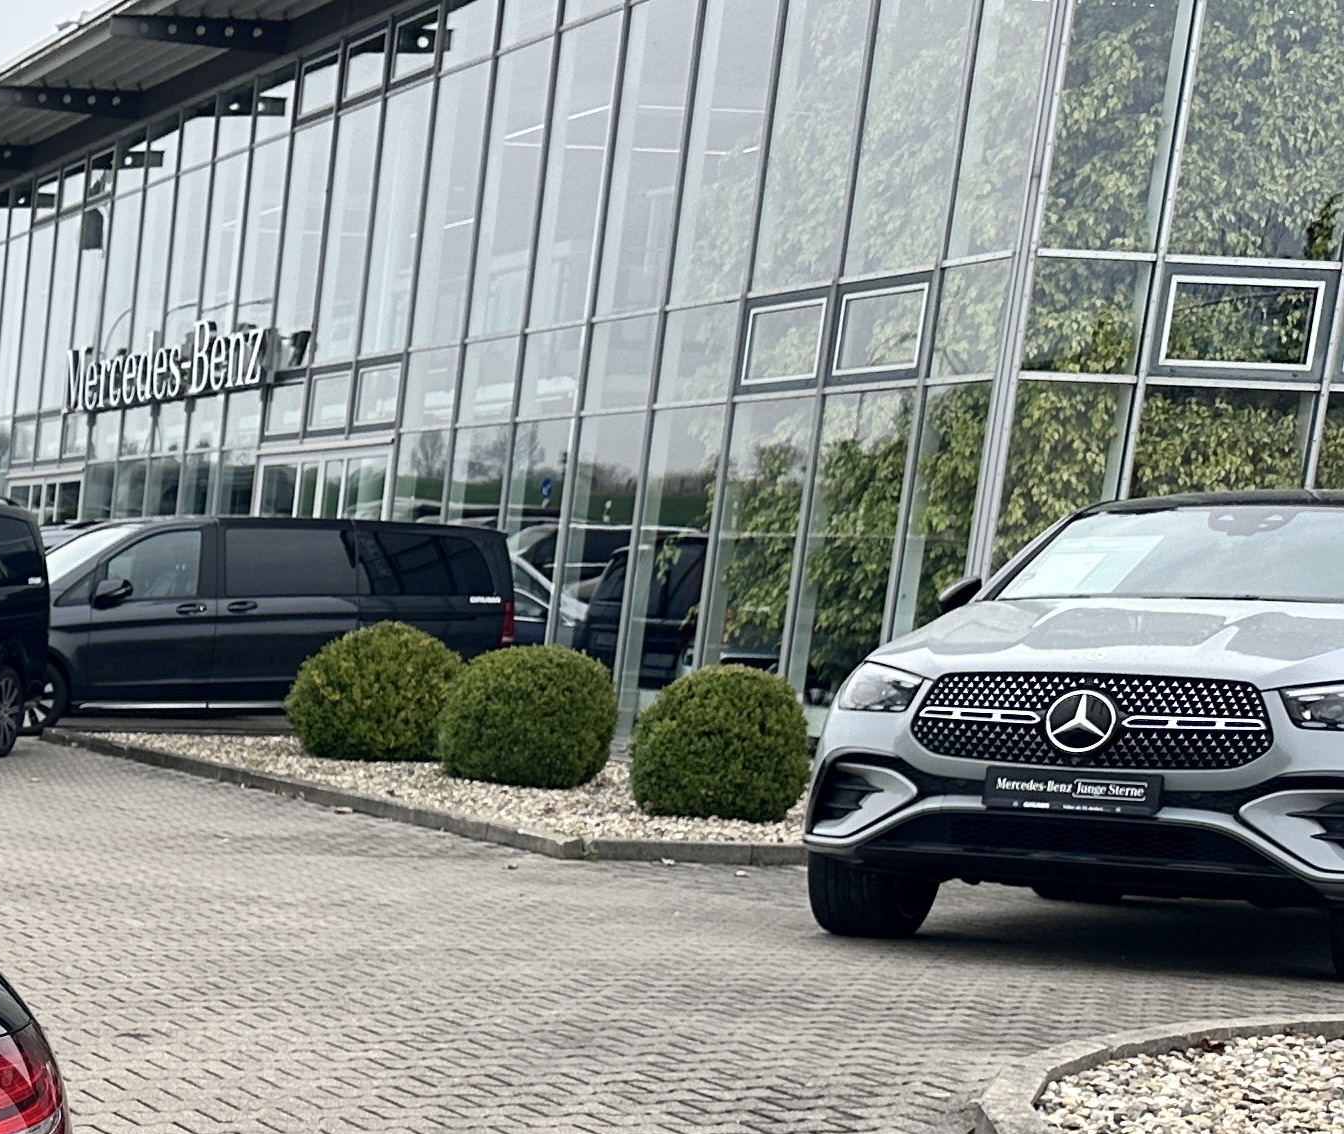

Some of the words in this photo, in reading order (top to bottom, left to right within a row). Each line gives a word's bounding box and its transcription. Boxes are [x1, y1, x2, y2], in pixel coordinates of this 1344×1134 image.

[63, 320, 264, 414] Mercedes-Benz
[996, 777, 1072, 793] Mercedes-Benz
[1108, 783, 1145, 797] Sterne
